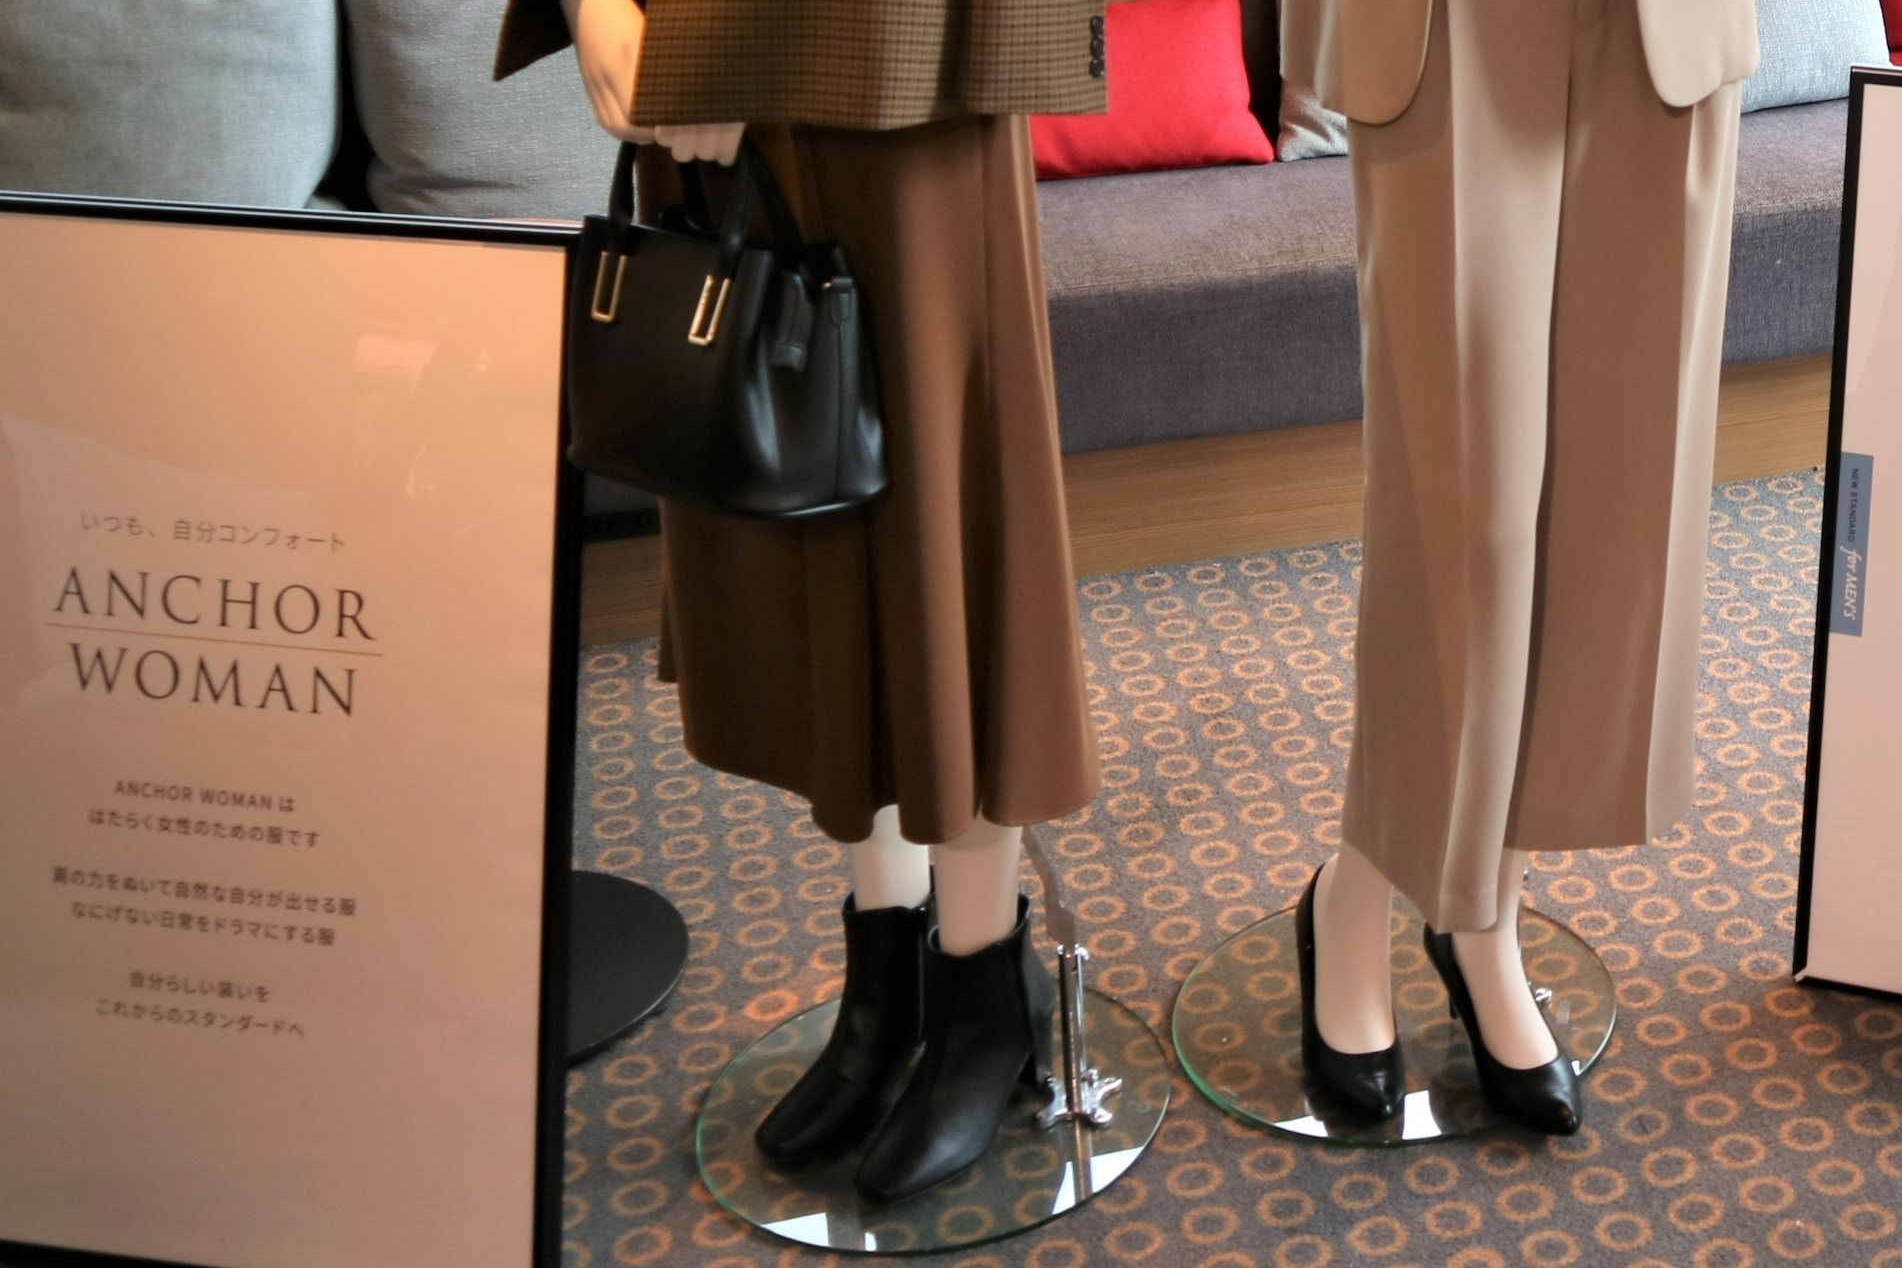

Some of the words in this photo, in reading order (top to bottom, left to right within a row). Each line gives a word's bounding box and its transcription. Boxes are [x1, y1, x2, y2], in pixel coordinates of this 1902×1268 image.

[1851, 467, 1860, 491] NEW
[1847, 492, 1859, 543] STANDARD
[1840, 545, 1862, 574] for
[53, 565, 377, 641] ANCHOR
[68, 641, 358, 718] WOMAN
[113, 779, 193, 803] ANCHOR
[199, 788, 273, 811] WOMAN
[277, 796, 296, 813] は
[88, 808, 321, 848] はたらく女性のための服です
[51, 865, 357, 917] 肩の力をぬいて自然な自分が出せる服
[71, 900, 336, 947] なにげない日常をドラマにする服
[128, 970, 271, 1004] 自分らしい装いを
[95, 997, 306, 1038] これからのスタンダードへ
